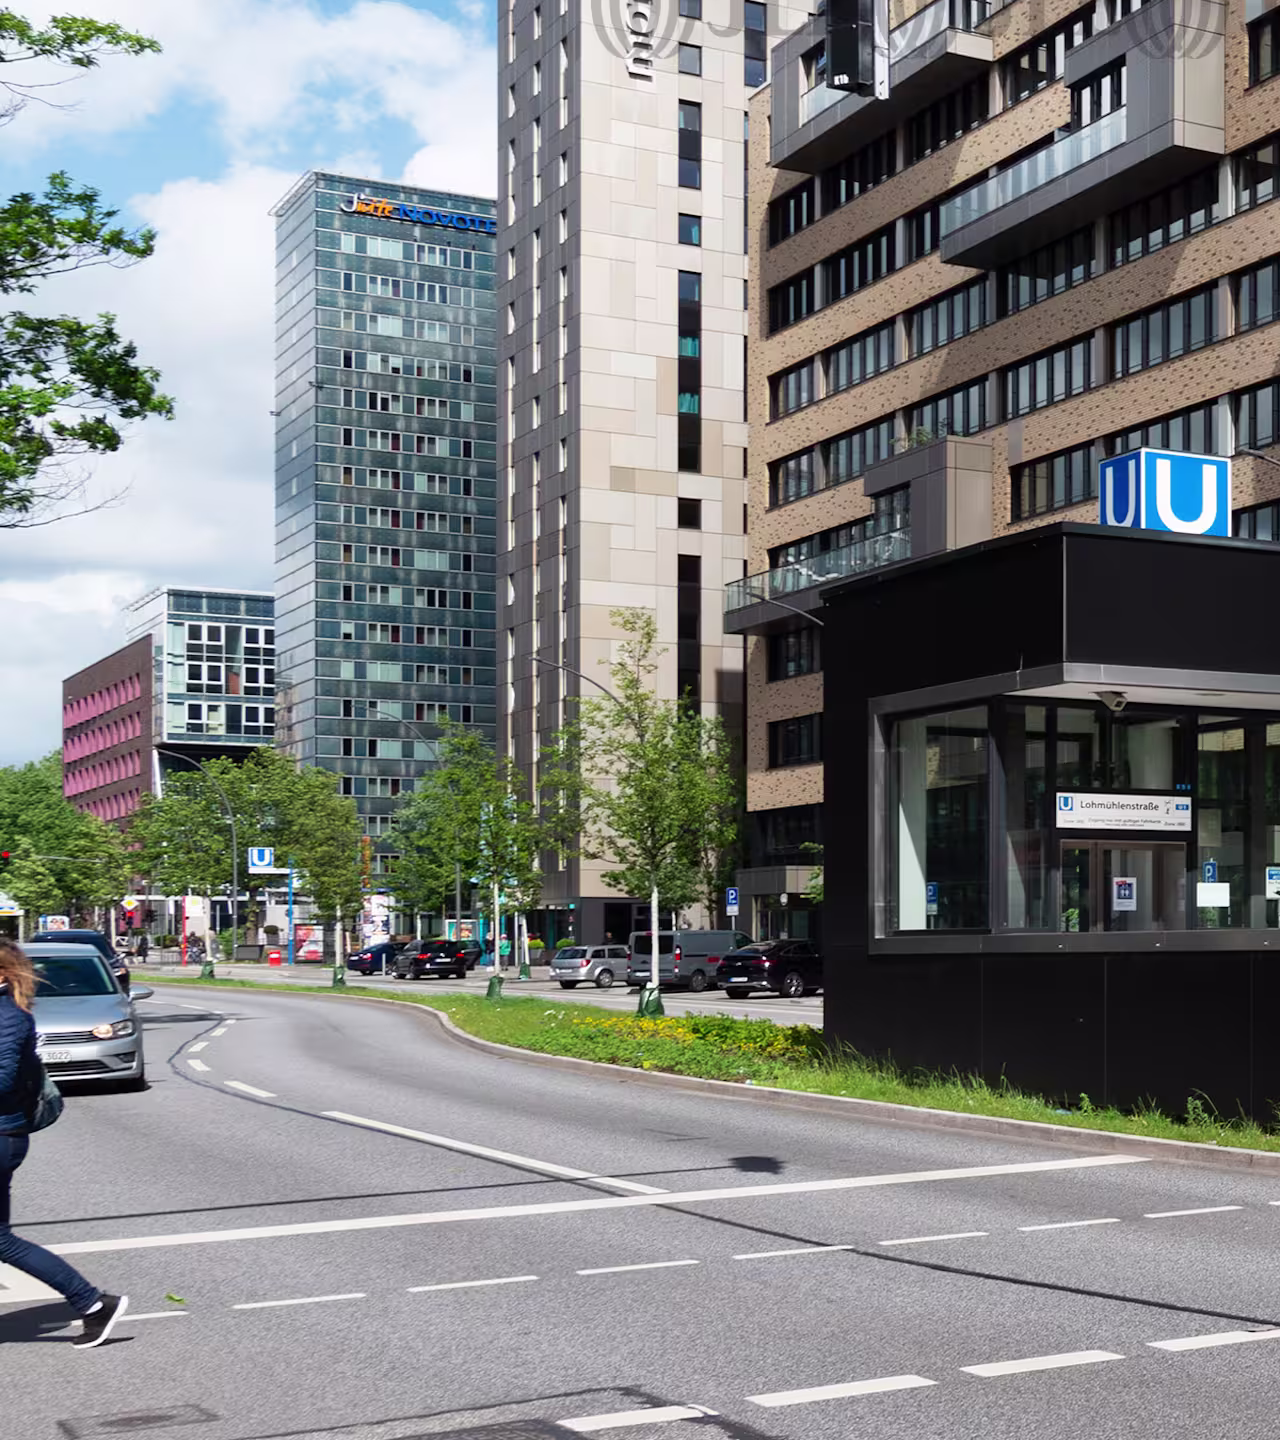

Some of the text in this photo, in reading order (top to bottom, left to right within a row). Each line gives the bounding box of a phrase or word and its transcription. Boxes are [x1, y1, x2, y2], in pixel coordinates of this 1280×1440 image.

[1106, 459, 1136, 527] U
[1156, 458, 1217, 534] U
[1060, 797, 1072, 810] U
[1080, 800, 1159, 811] Lohmühlenstraße
[253, 849, 270, 865] U
